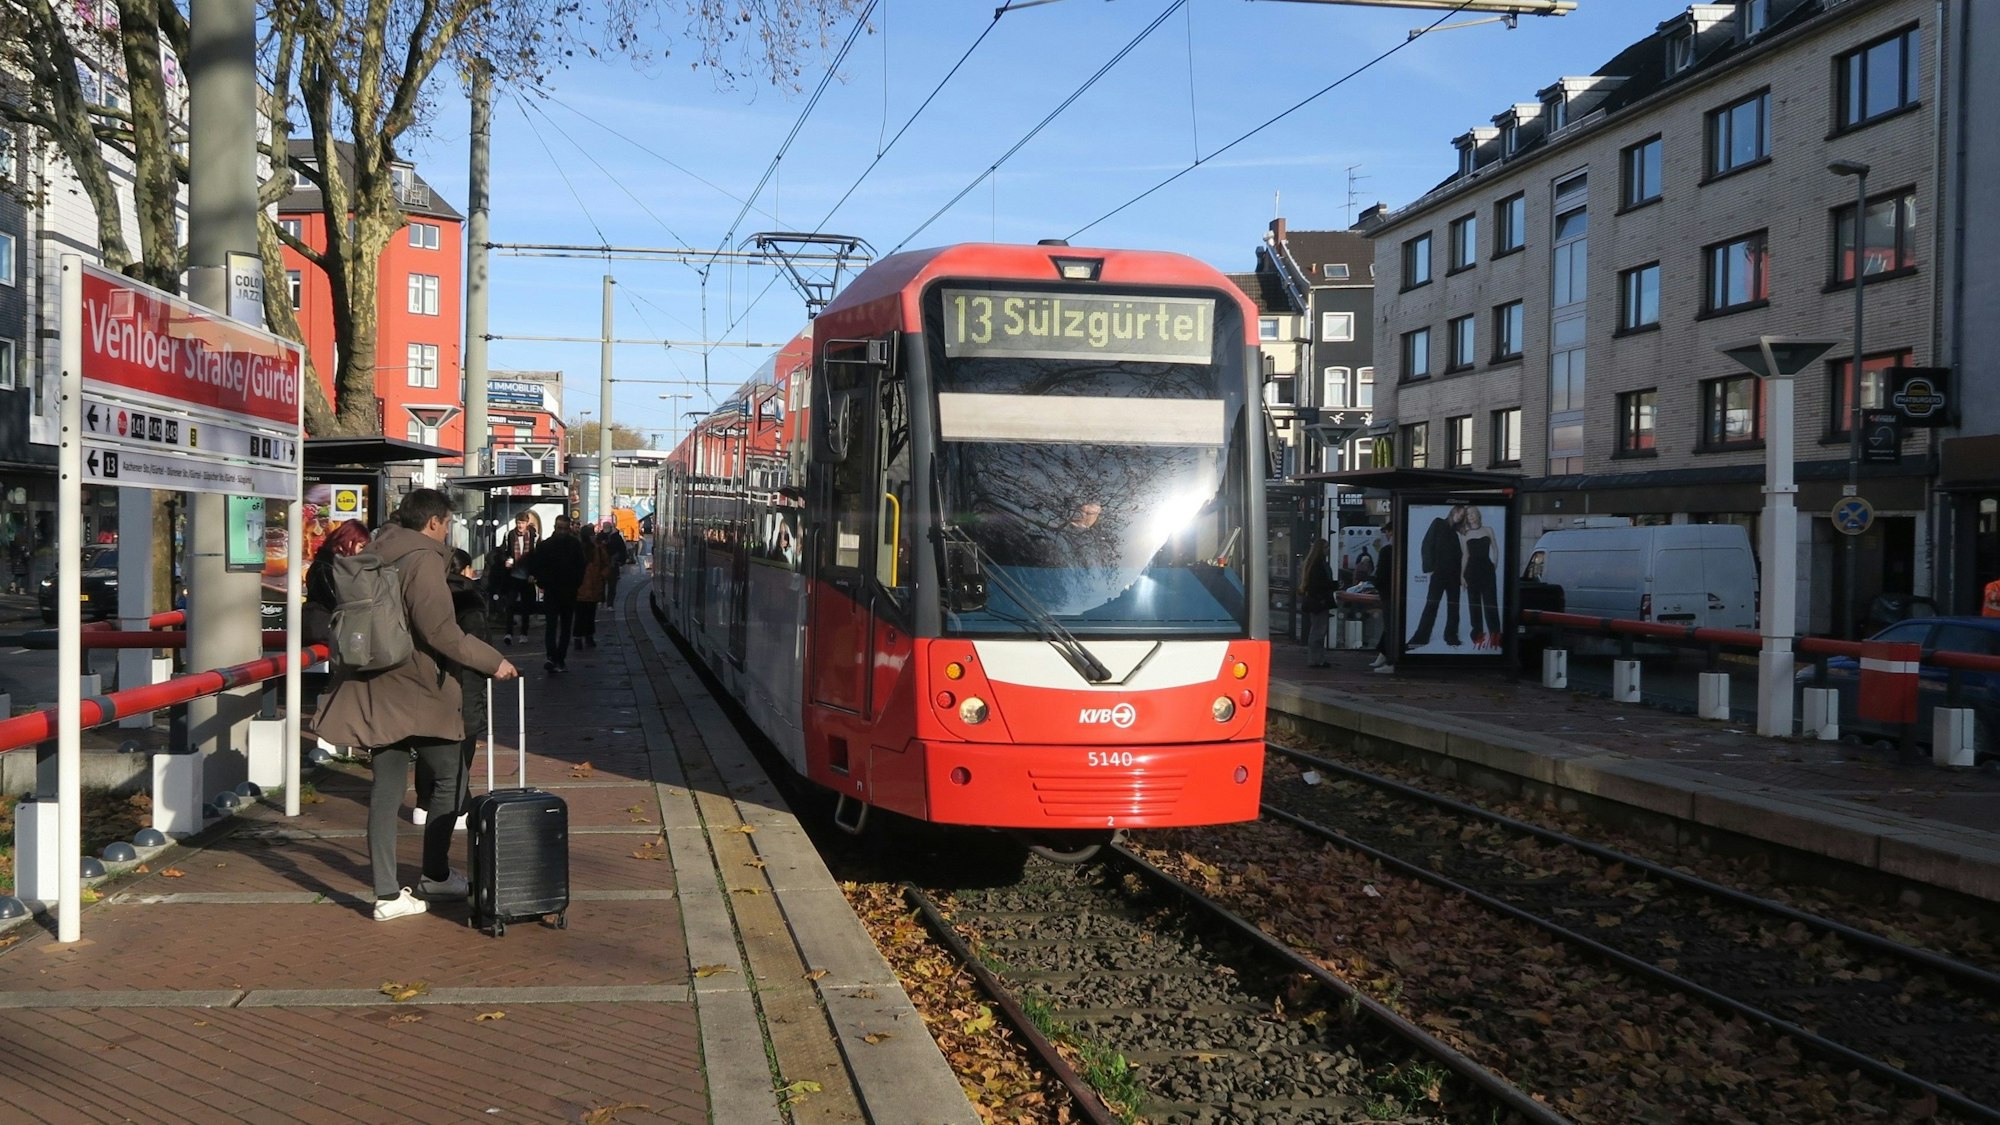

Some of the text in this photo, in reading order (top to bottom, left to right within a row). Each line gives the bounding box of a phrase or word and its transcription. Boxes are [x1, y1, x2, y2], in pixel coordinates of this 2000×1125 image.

[955, 295, 1206, 348] 13 Sülzgürtel
[88, 298, 298, 407] Venloer Straße/Gürtel
[494, 382, 543, 394] IMMOBILIEN
[132, 418, 145, 435] 141
[149, 421, 162, 438] 142
[166, 423, 177, 440] 143
[106, 456, 116, 474] 13
[411, 472, 448, 484] KISK
[1079, 709, 1112, 724] KVB
[1087, 751, 1133, 766] 5140
[1107, 816, 1114, 826] 2
